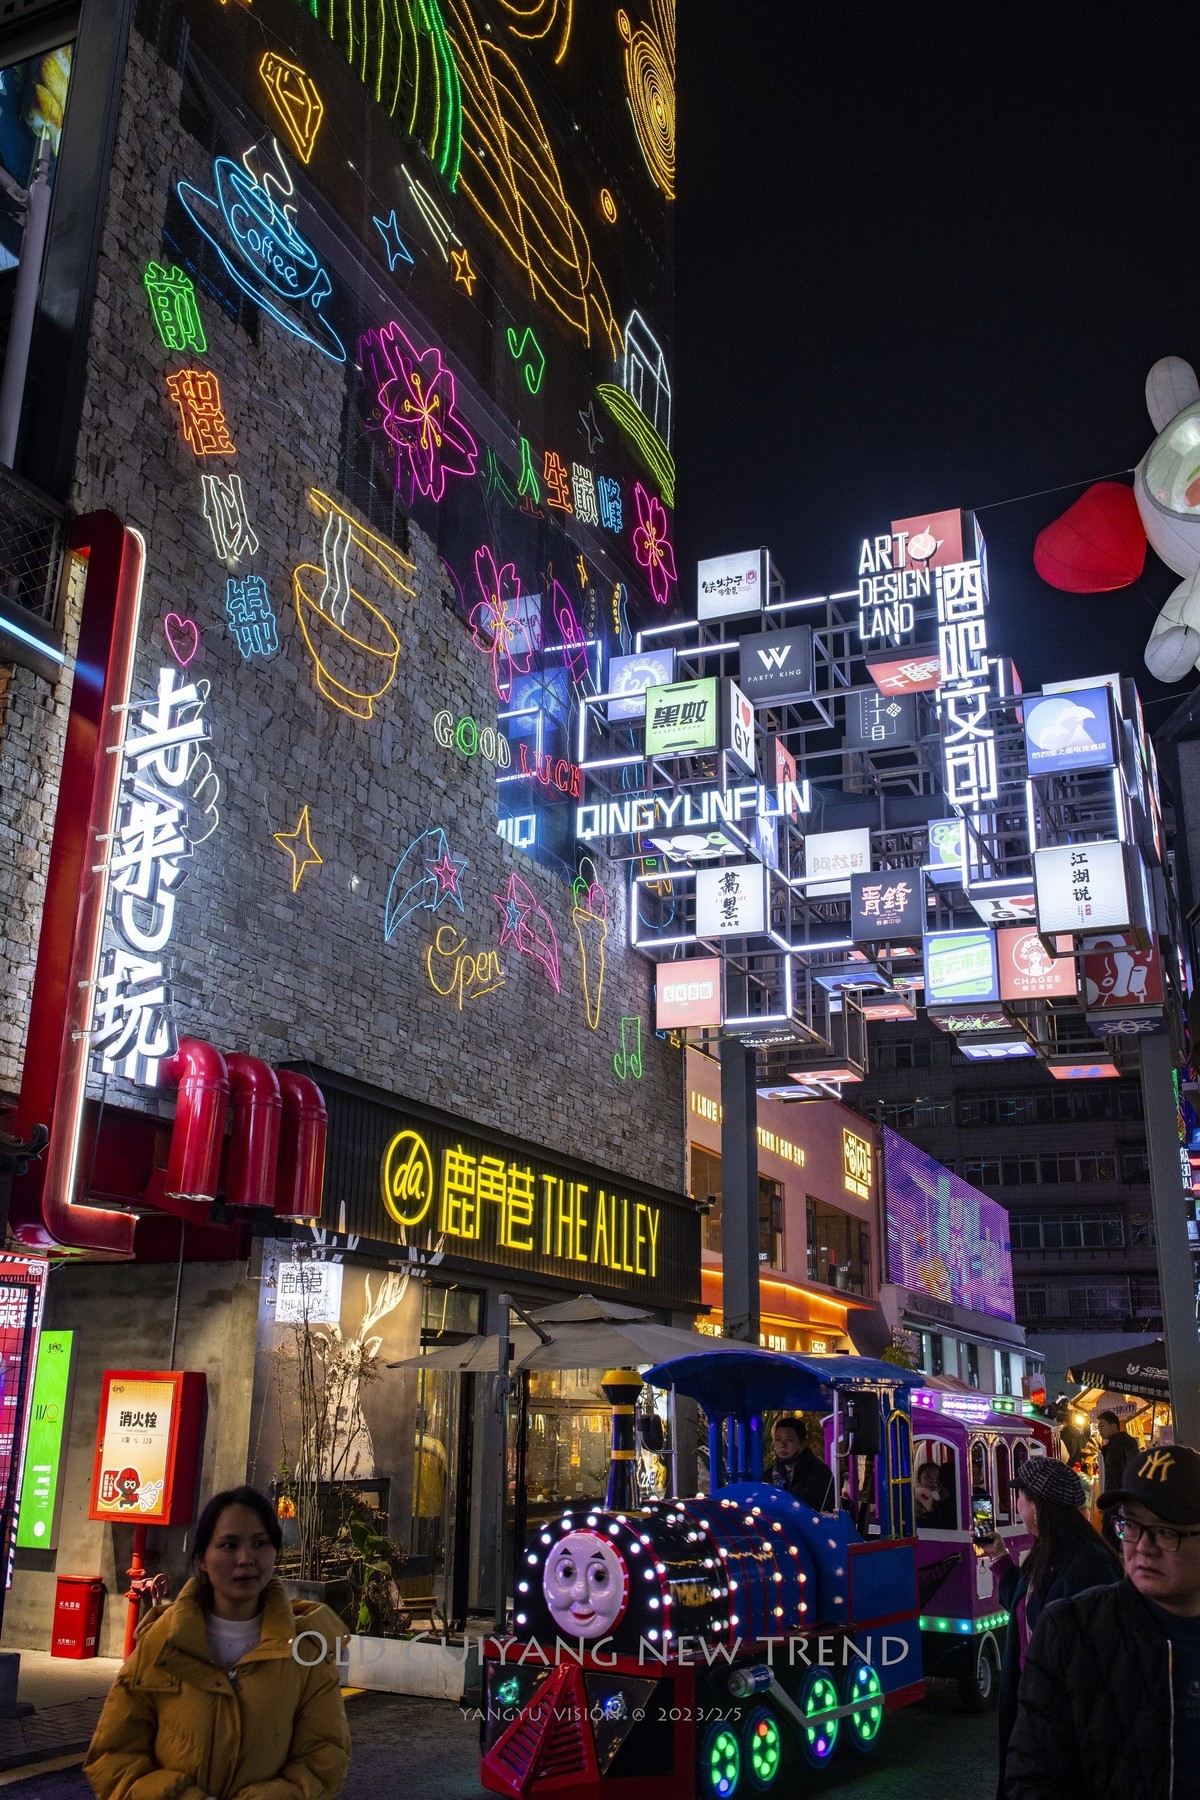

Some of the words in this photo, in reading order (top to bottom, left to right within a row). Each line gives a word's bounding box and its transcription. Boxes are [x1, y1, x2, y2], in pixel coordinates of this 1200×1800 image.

[231, 204, 298, 287] Coffee
[859, 531, 909, 575] ART
[858, 567, 930, 608] DESIGN
[859, 602, 915, 640] LAND
[748, 673, 774, 683] PARTY
[780, 668, 802, 678] KING
[935, 559, 998, 805] 酒吧文创
[433, 710, 511, 768] GOOD
[519, 743, 581, 797] LUCK
[734, 723, 750, 758] GY
[576, 780, 810, 840] QINGYUNFUN
[1070, 852, 1092, 901] 江湖说
[428, 925, 505, 1010] Open
[1013, 975, 1062, 985] CHAGEE
[691, 1091, 695, 1111] I
[698, 1094, 717, 1122] LOVE
[440, 1145, 534, 1250] 鹿角巷
[543, 1174, 588, 1261] THE
[593, 1190, 660, 1277] ALLEY
[119, 1411, 157, 1428] 消火栓
